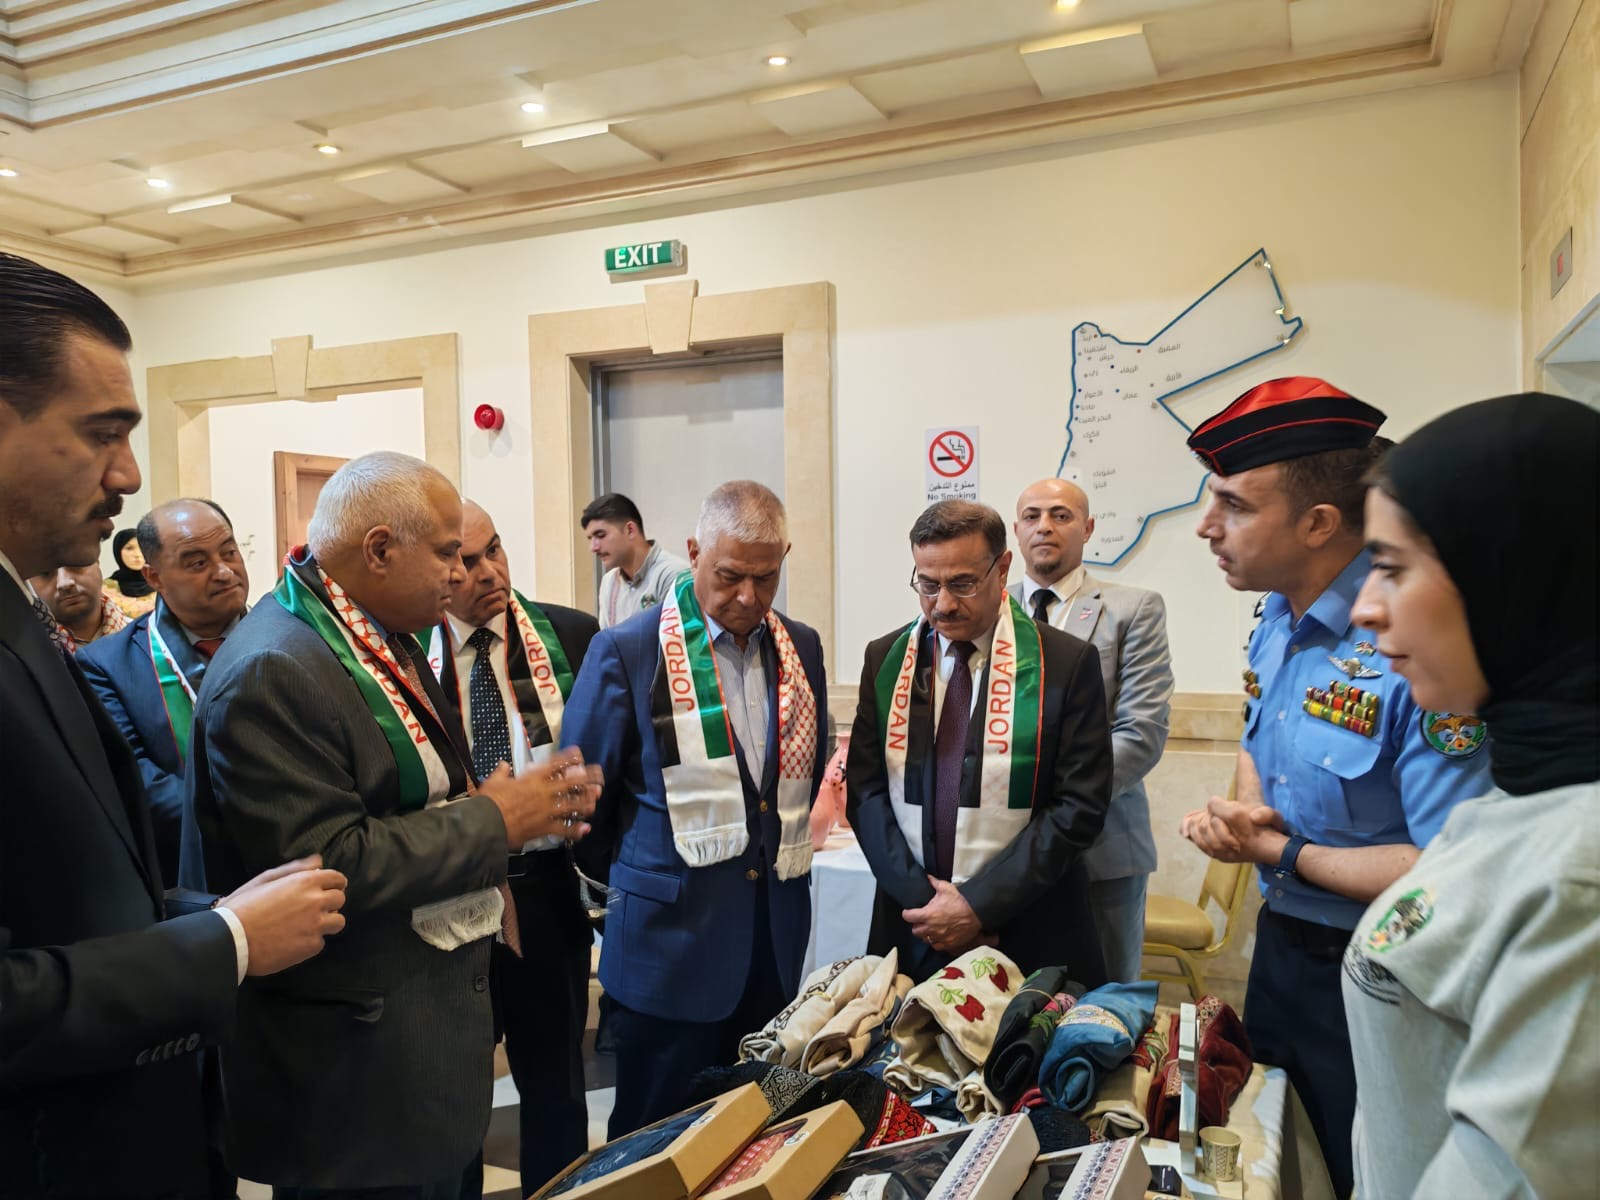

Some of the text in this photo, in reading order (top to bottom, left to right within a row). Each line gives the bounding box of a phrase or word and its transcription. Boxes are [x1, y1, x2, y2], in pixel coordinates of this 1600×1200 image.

[614, 242, 662, 269] EXIT
[927, 491, 977, 501] No Smoking
[953, 481, 975, 493] ممنوع
[352, 633, 428, 745] RDAN
[509, 600, 557, 695] JORDAN
[660, 606, 696, 712] JORDAN
[987, 639, 1014, 755] JORDAN
